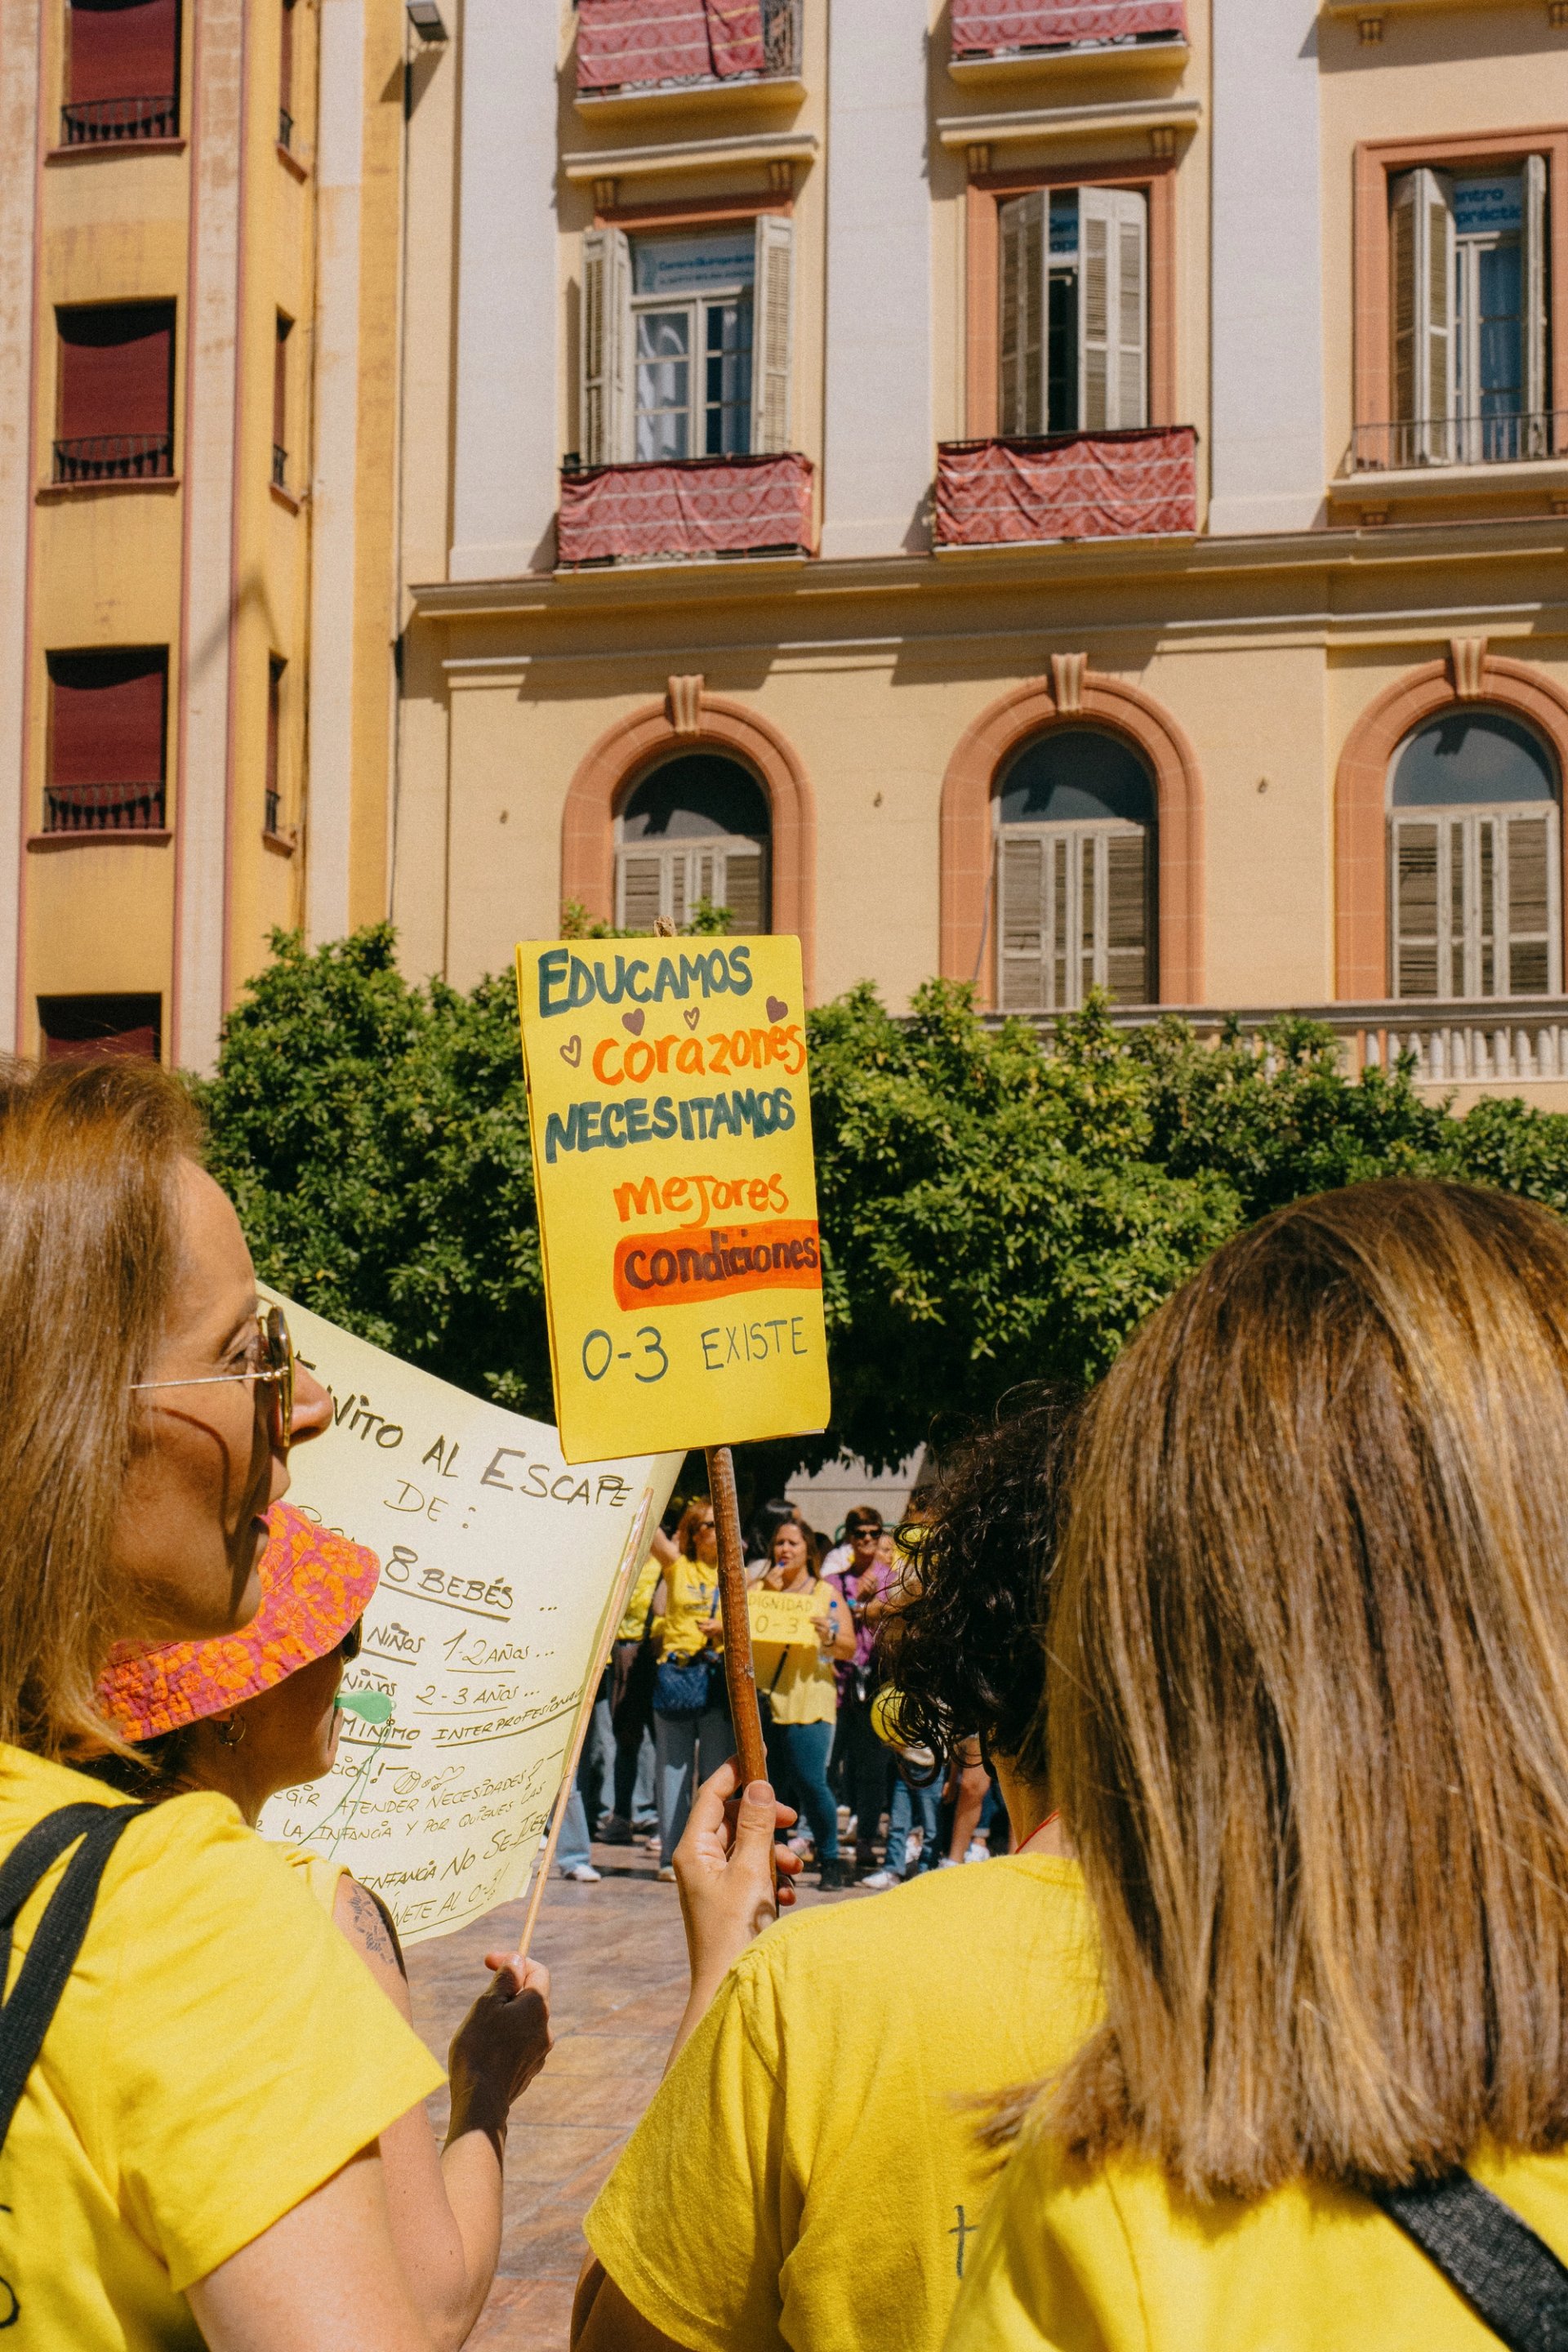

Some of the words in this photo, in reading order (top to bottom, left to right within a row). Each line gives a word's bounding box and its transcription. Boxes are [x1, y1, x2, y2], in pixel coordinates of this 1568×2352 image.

[537, 946, 752, 1018] EDUCAMOS
[546, 1086, 796, 1164] NECESITAMOS
[581, 1325, 669, 1384] 0-3
[702, 1316, 808, 1371] EXISTE
[421, 1435, 460, 1477] AL
[480, 1447, 634, 1506] ESCAPE
[283, 1819, 305, 1838] LA
[407, 1820, 419, 1836] Y
[423, 1818, 450, 1833] POR
[440, 1848, 476, 1881] NO
